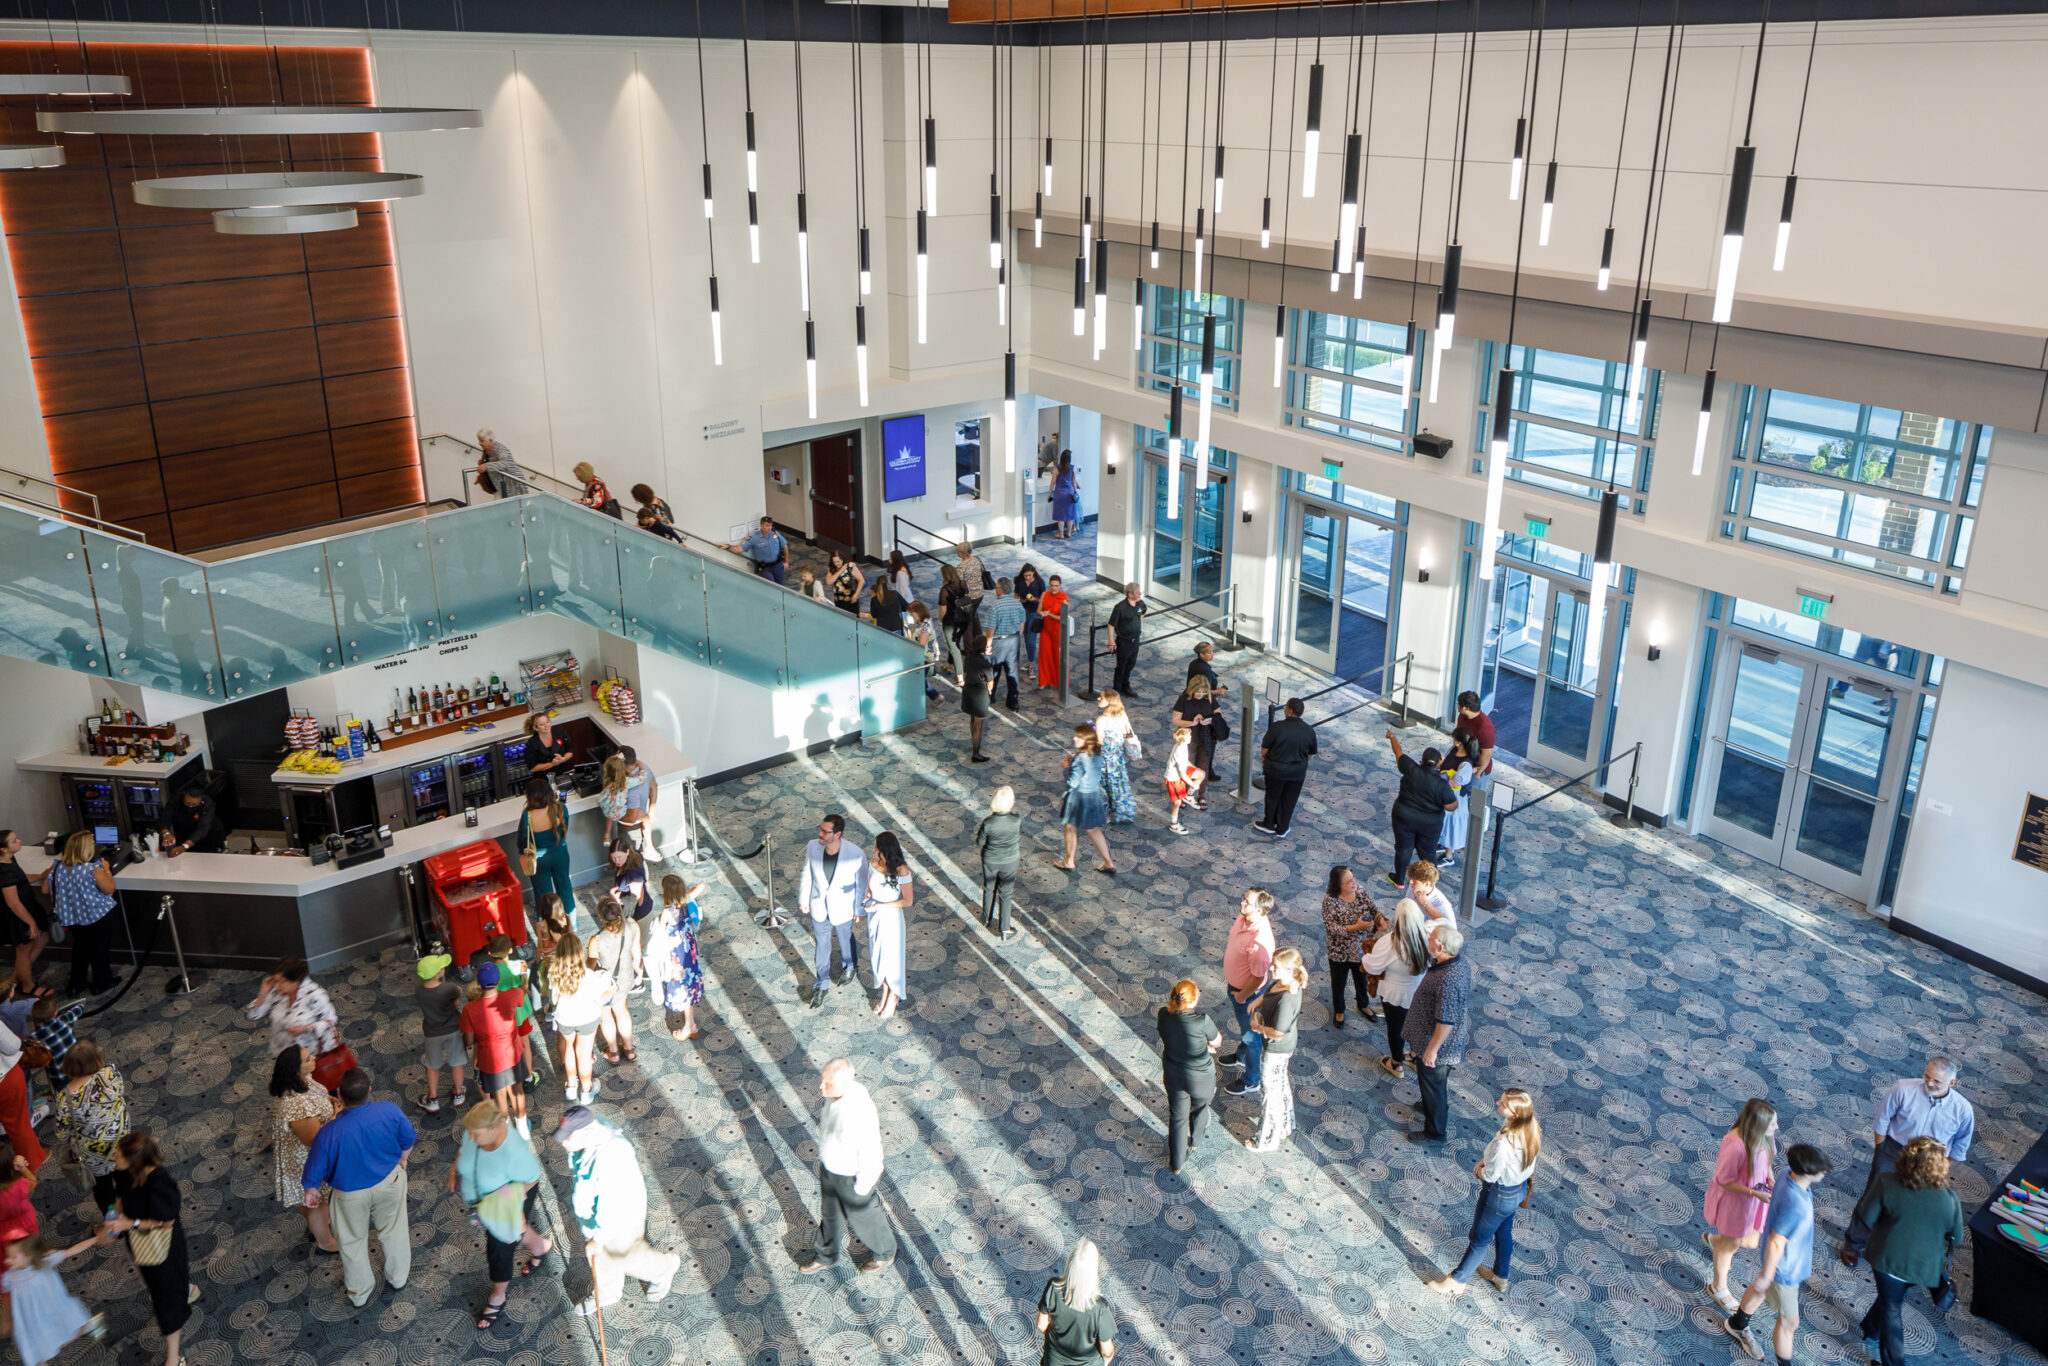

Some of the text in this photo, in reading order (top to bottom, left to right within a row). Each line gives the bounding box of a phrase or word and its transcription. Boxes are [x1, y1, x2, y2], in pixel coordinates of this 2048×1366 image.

[1325, 463, 1340, 480] EXIT
[1528, 519, 1546, 539] EXIT
[1800, 596, 1827, 618] EXIT
[438, 635, 469, 646] PRETZELS
[439, 646, 460, 655] CHIPS
[373, 660, 398, 671] WATER
